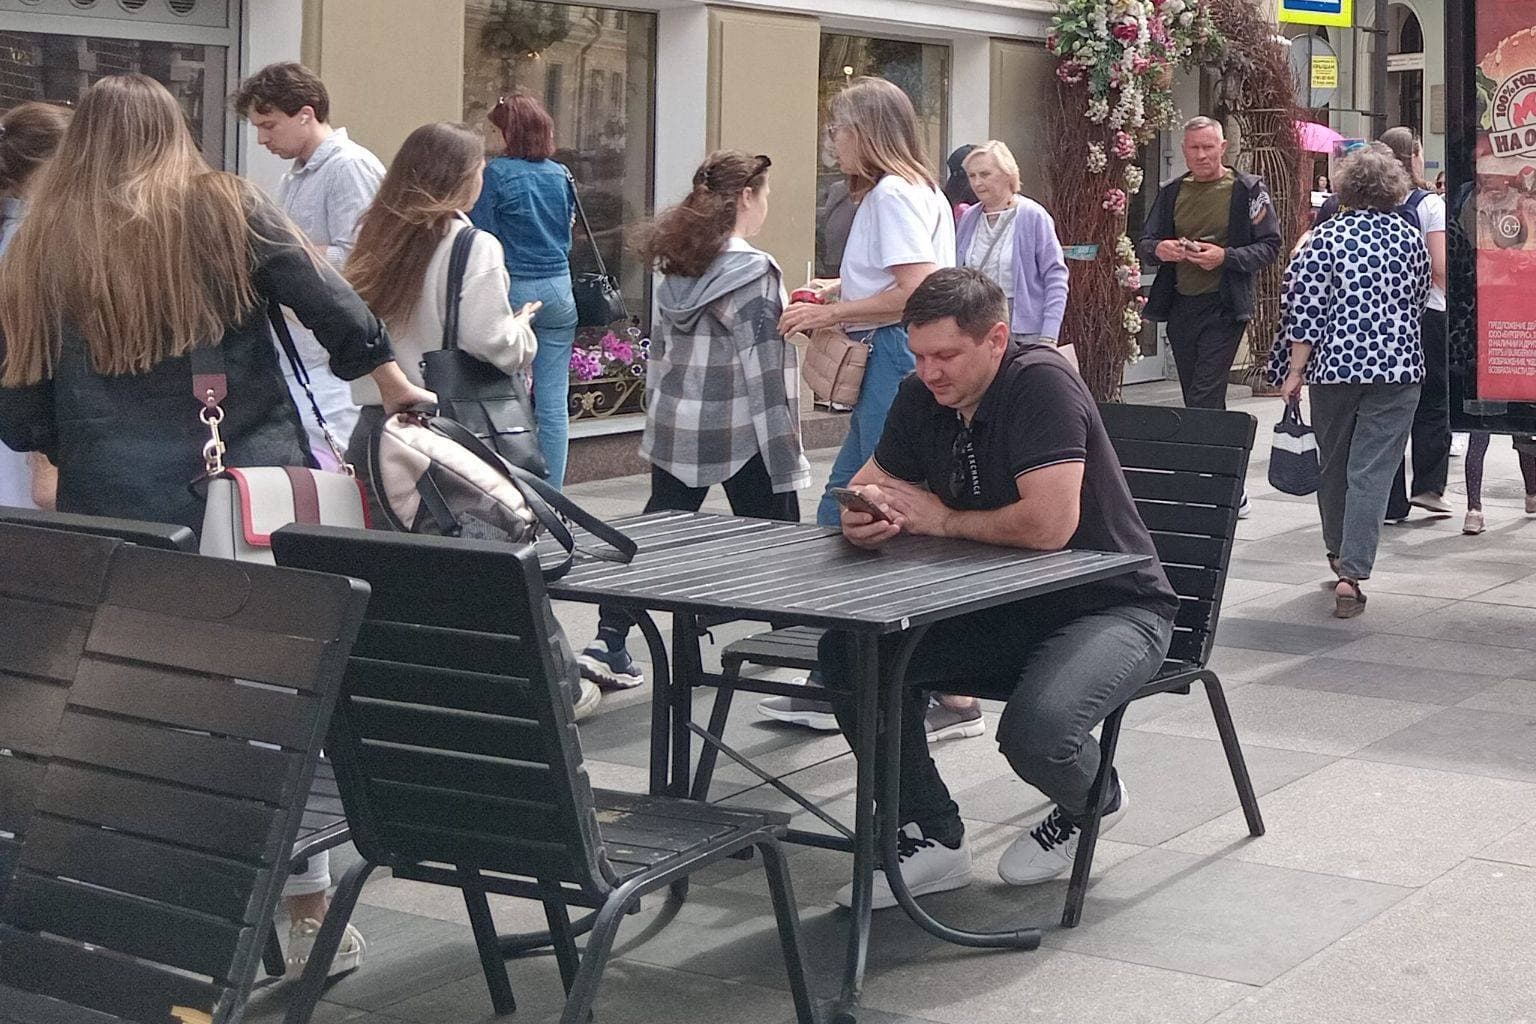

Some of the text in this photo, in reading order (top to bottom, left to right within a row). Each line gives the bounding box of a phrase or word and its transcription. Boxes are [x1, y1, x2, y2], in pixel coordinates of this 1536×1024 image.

[1496, 84, 1517, 118] 100%
[1494, 132, 1522, 153] НА
[1502, 221, 1521, 234] 6+
